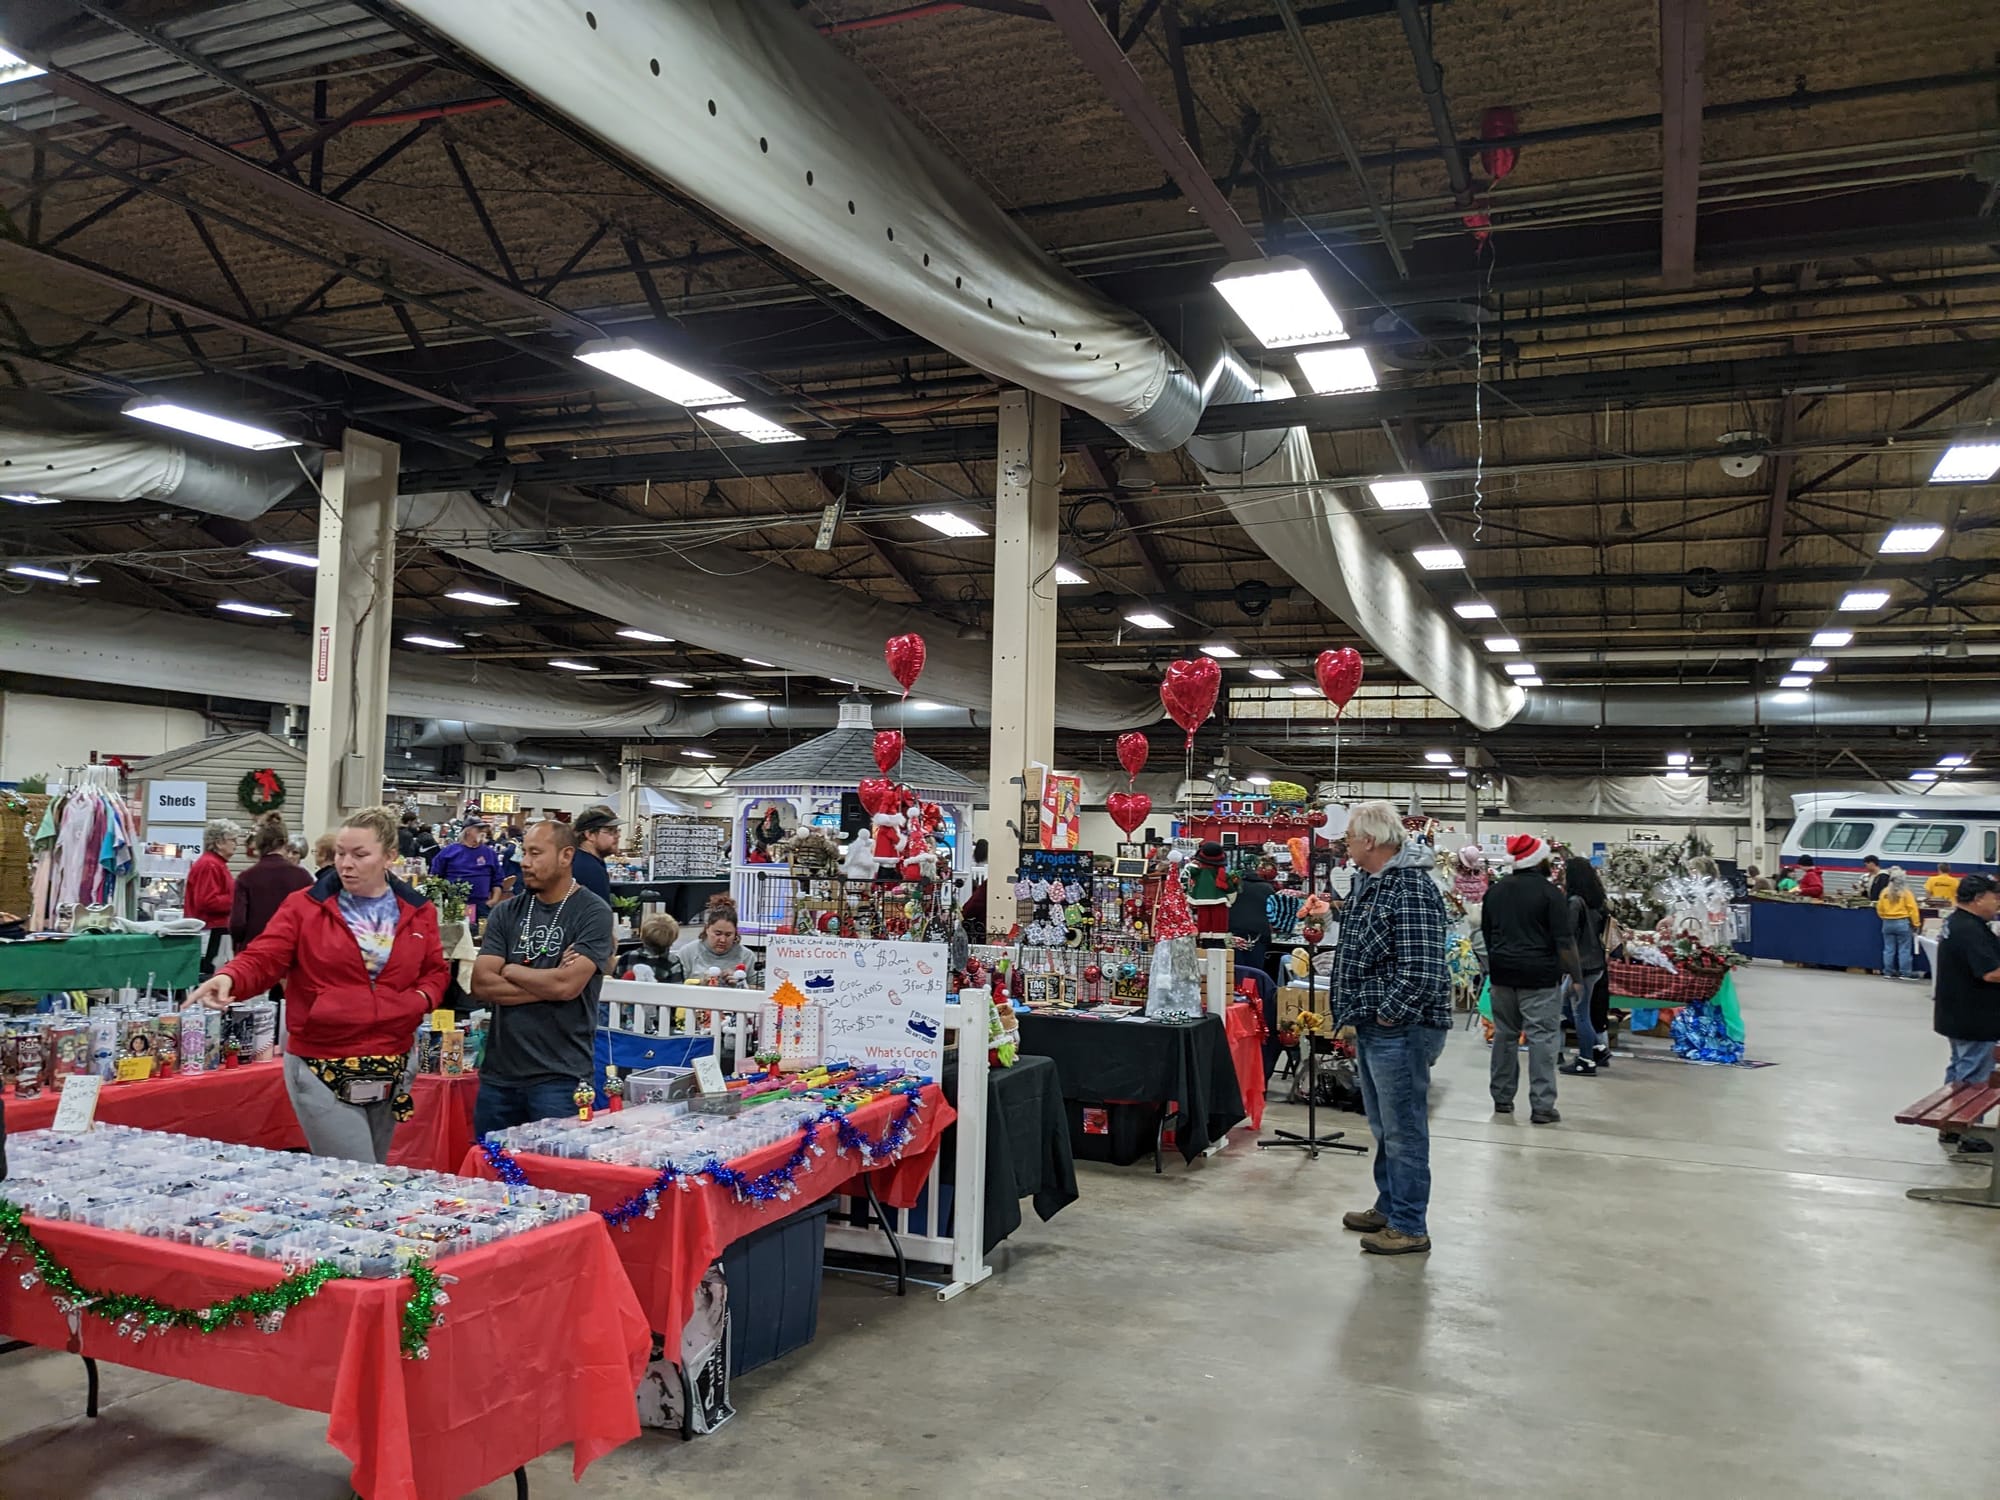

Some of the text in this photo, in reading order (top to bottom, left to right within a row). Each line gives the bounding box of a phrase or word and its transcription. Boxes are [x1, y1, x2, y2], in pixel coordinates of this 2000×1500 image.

[159, 795, 196, 807] Sheds
[1035, 852, 1077, 865] Project
[777, 947, 847, 959] What's Croc'n
[1029, 981, 1046, 989] TAG
[865, 1047, 937, 1059] What's Croc'n
